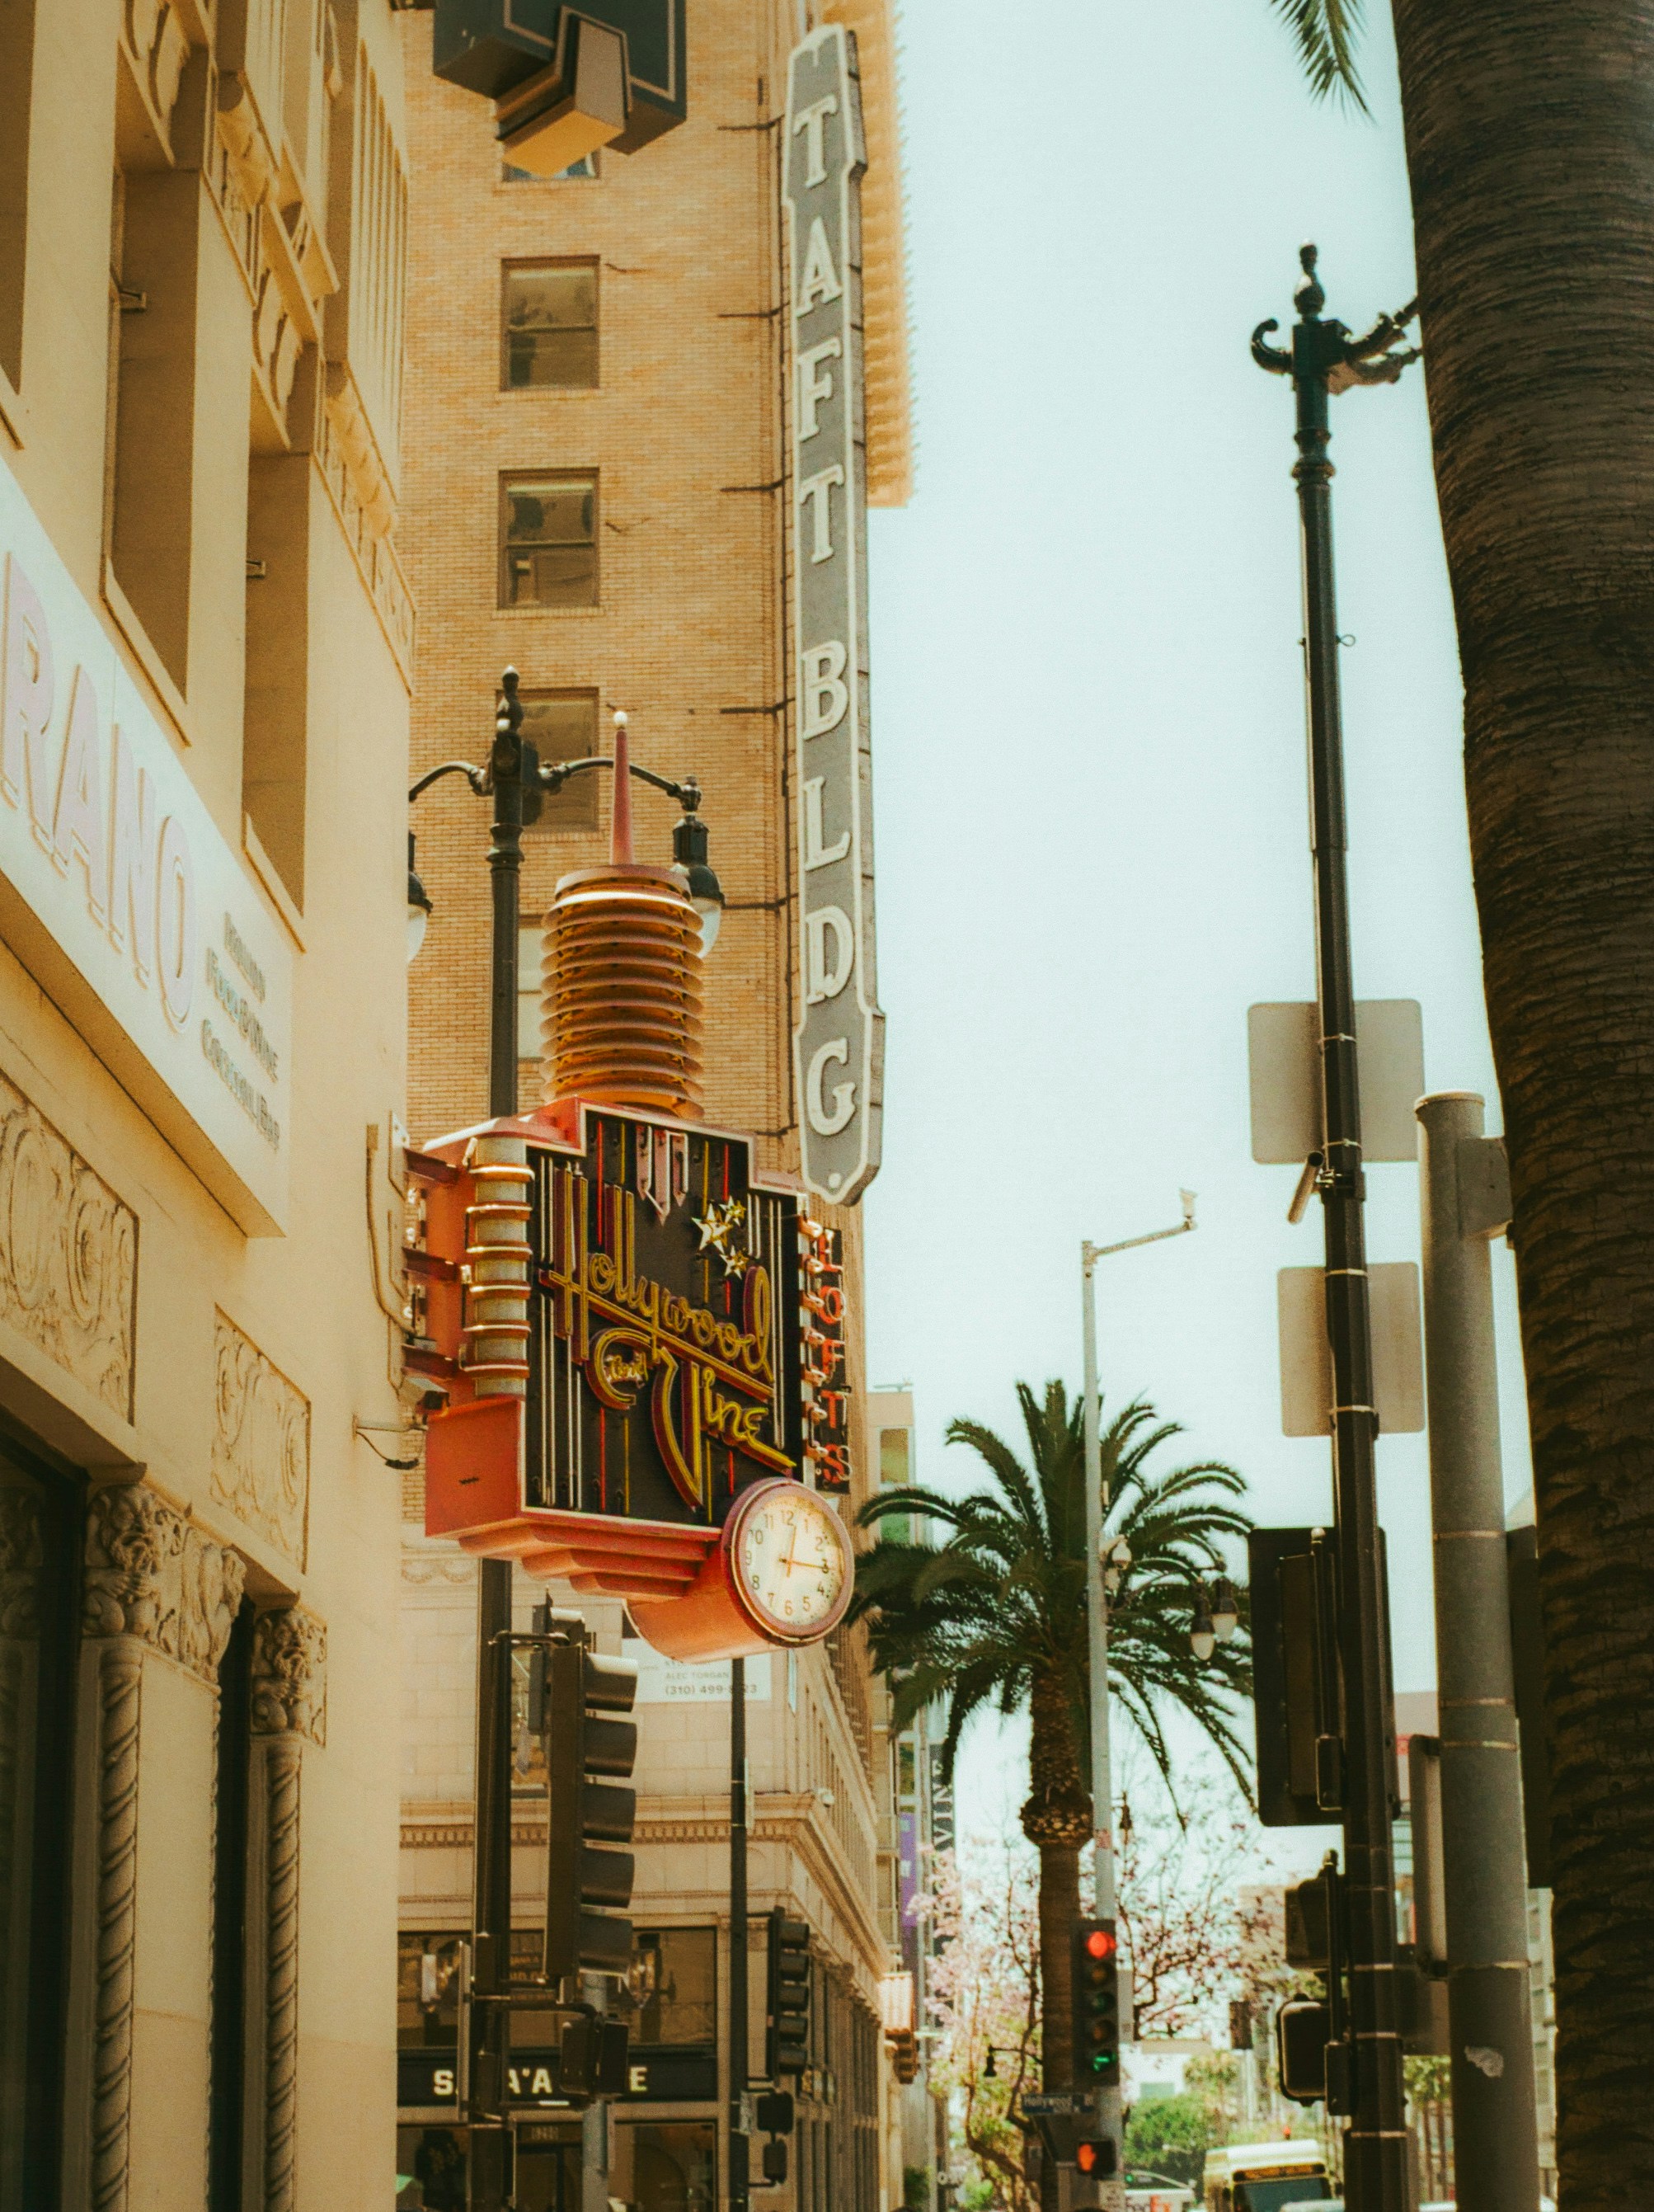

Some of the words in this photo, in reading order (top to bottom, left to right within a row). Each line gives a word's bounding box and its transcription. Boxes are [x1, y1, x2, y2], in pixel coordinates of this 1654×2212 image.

[793, 94, 845, 564] TAFT
[801, 639, 857, 1137] BLDG
[538, 1165, 776, 1400] Hollywood
[816, 1229, 853, 1485] LOFTS
[650, 1344, 798, 1511] Vine
[764, 1513, 775, 1530] 11
[781, 1509, 795, 1527] 12
[803, 1518, 811, 1532] 1
[749, 1529, 764, 1545] 10
[815, 1536, 824, 1552] 2
[751, 1574, 760, 1591] 8
[816, 1581, 825, 1596] 4
[767, 1593, 775, 1609] 7
[783, 1598, 793, 1617] 6
[801, 1595, 811, 1612] 5
[665, 1683, 696, 1696] (310)
